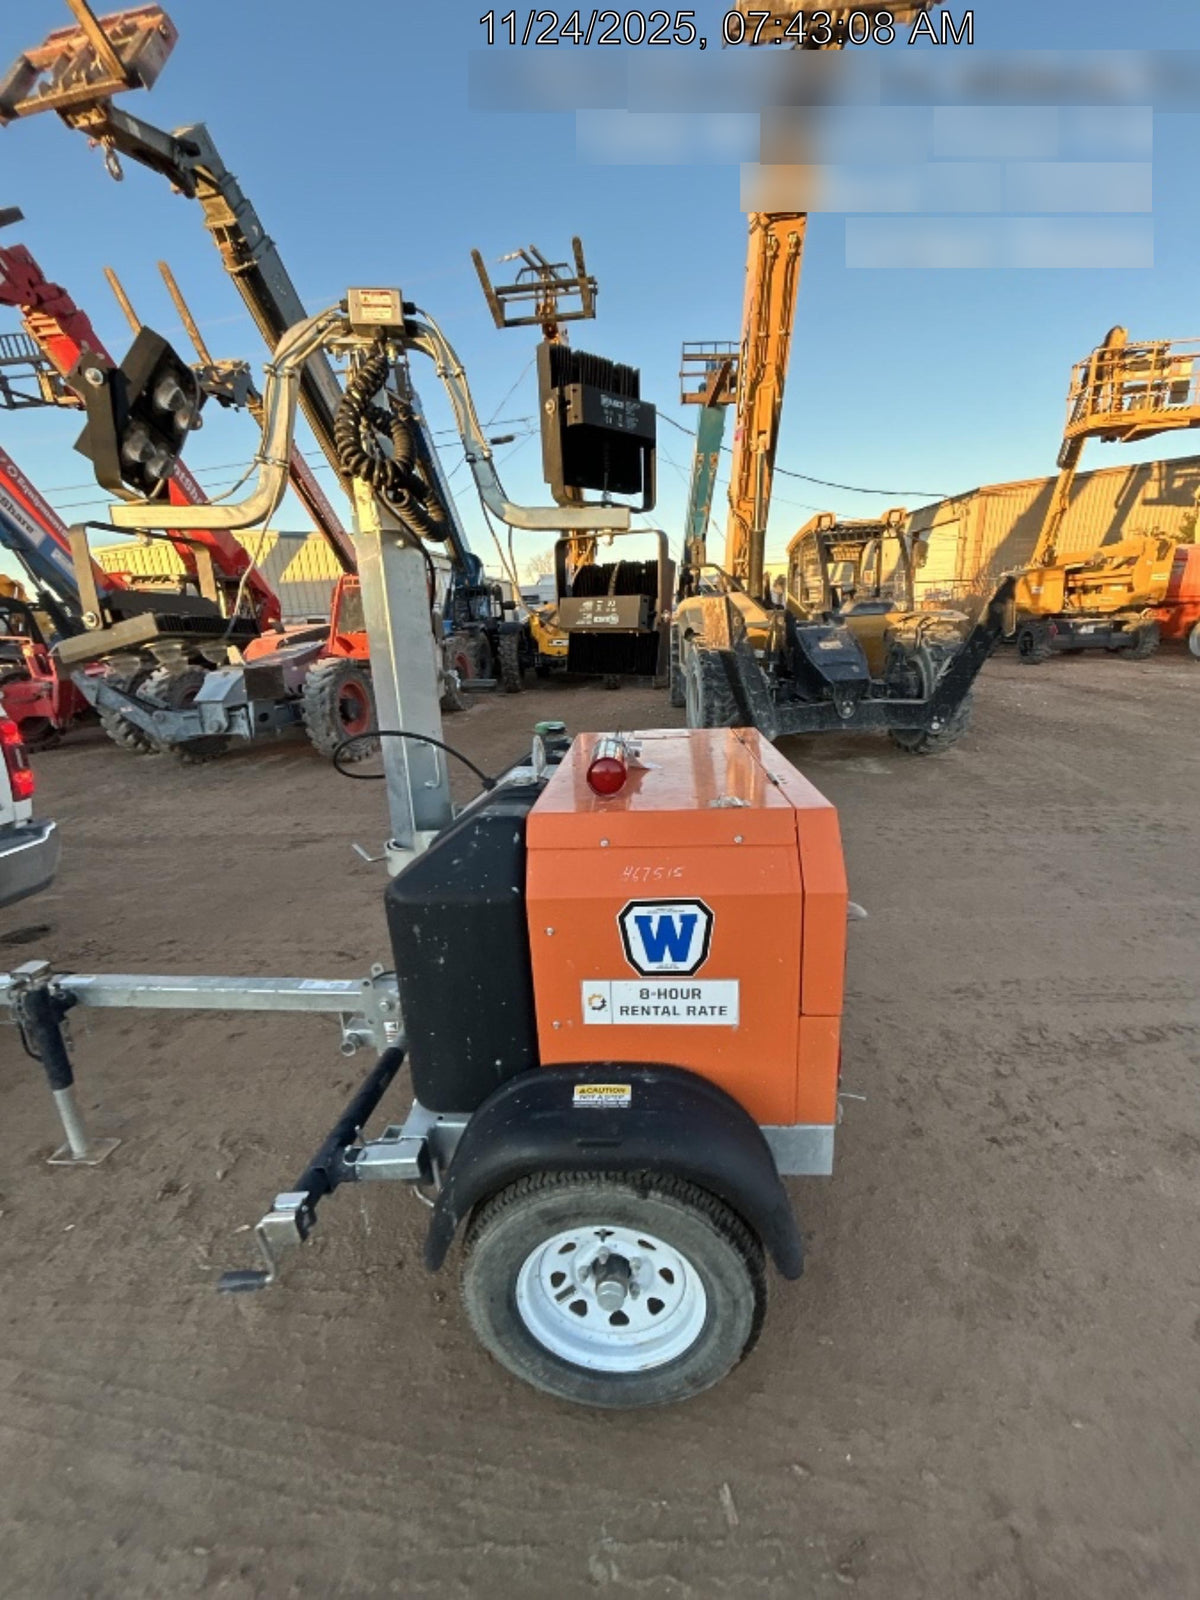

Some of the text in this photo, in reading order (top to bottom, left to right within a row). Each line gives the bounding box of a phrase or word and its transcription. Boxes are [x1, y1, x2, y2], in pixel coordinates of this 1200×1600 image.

[634, 913, 698, 963] W
[639, 987, 702, 1000] 8-HOUR
[619, 1005, 728, 1016] RENTAL RATE
